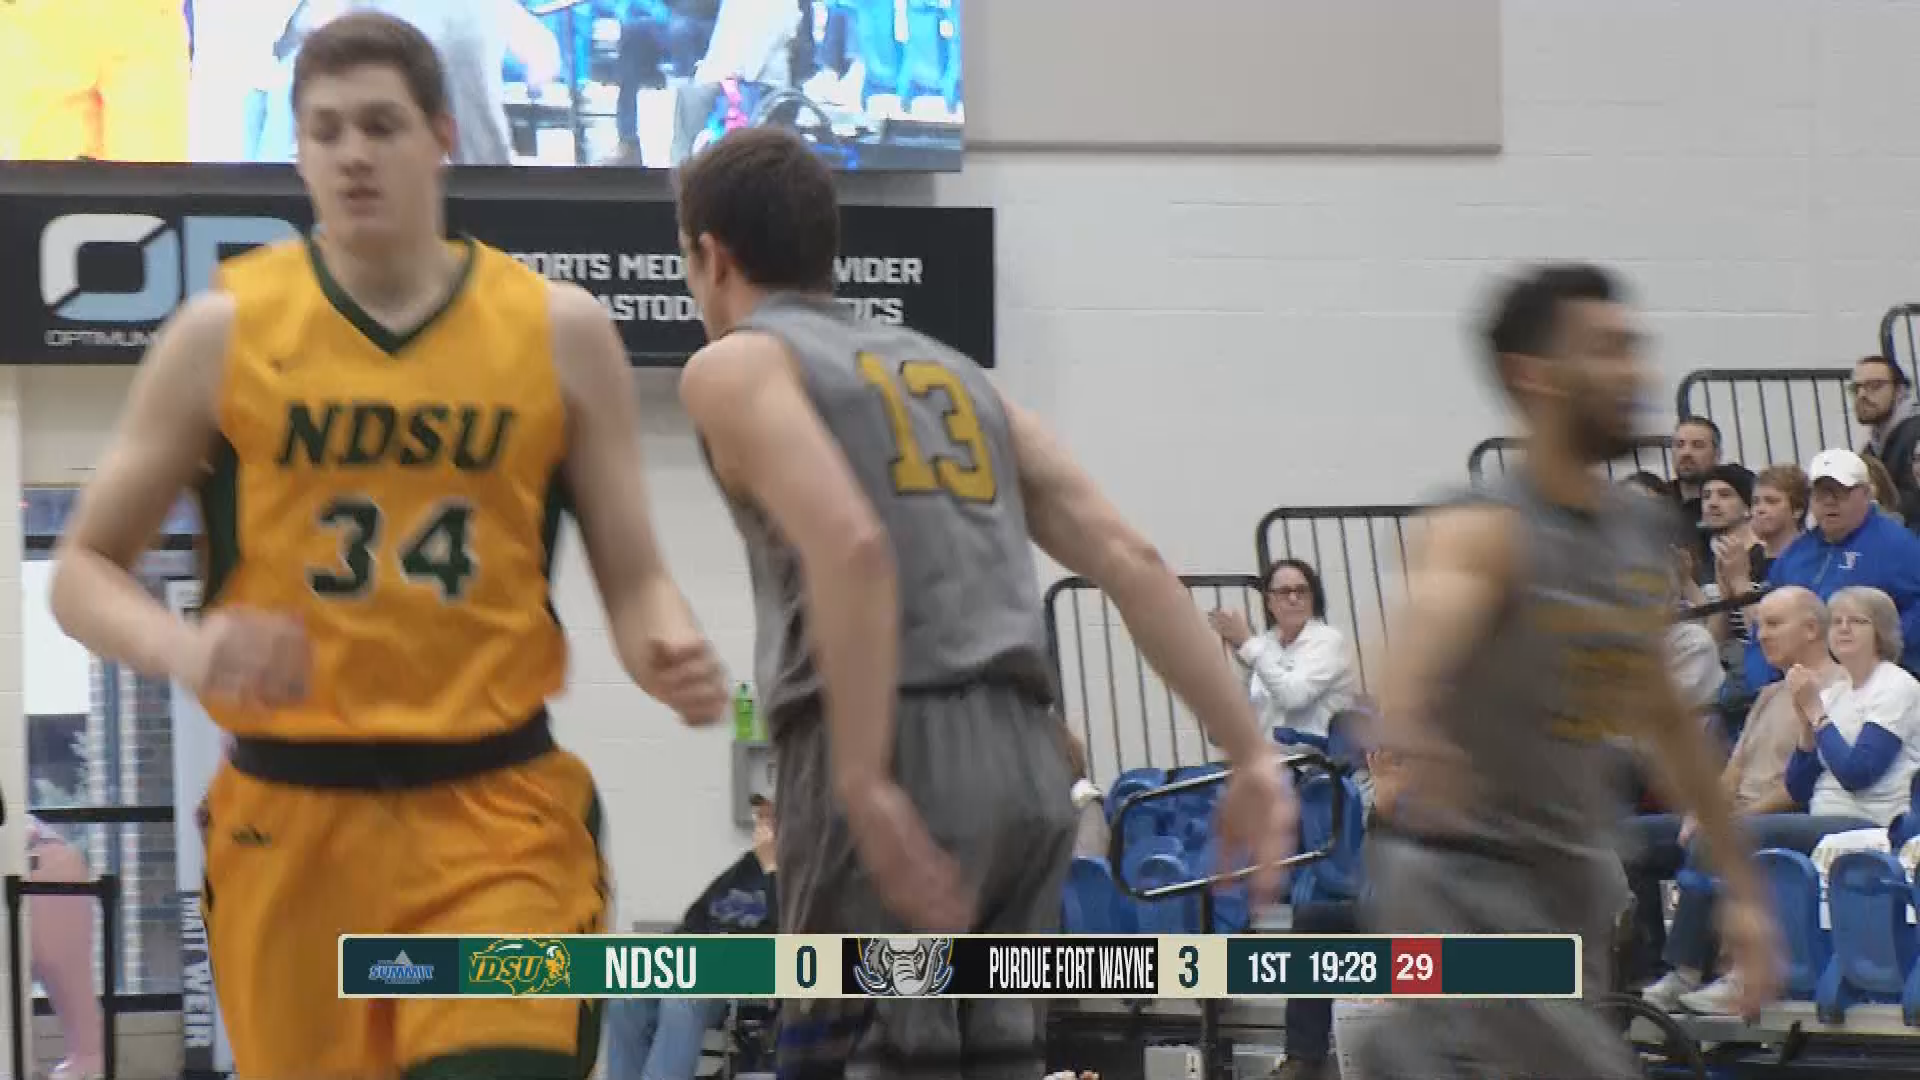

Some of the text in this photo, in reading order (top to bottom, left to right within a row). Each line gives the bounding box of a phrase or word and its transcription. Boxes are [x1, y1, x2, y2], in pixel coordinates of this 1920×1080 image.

[508, 253, 611, 280] ORTS
[274, 400, 518, 471] NDSU
[856, 350, 997, 503] 13
[305, 494, 480, 604] 34
